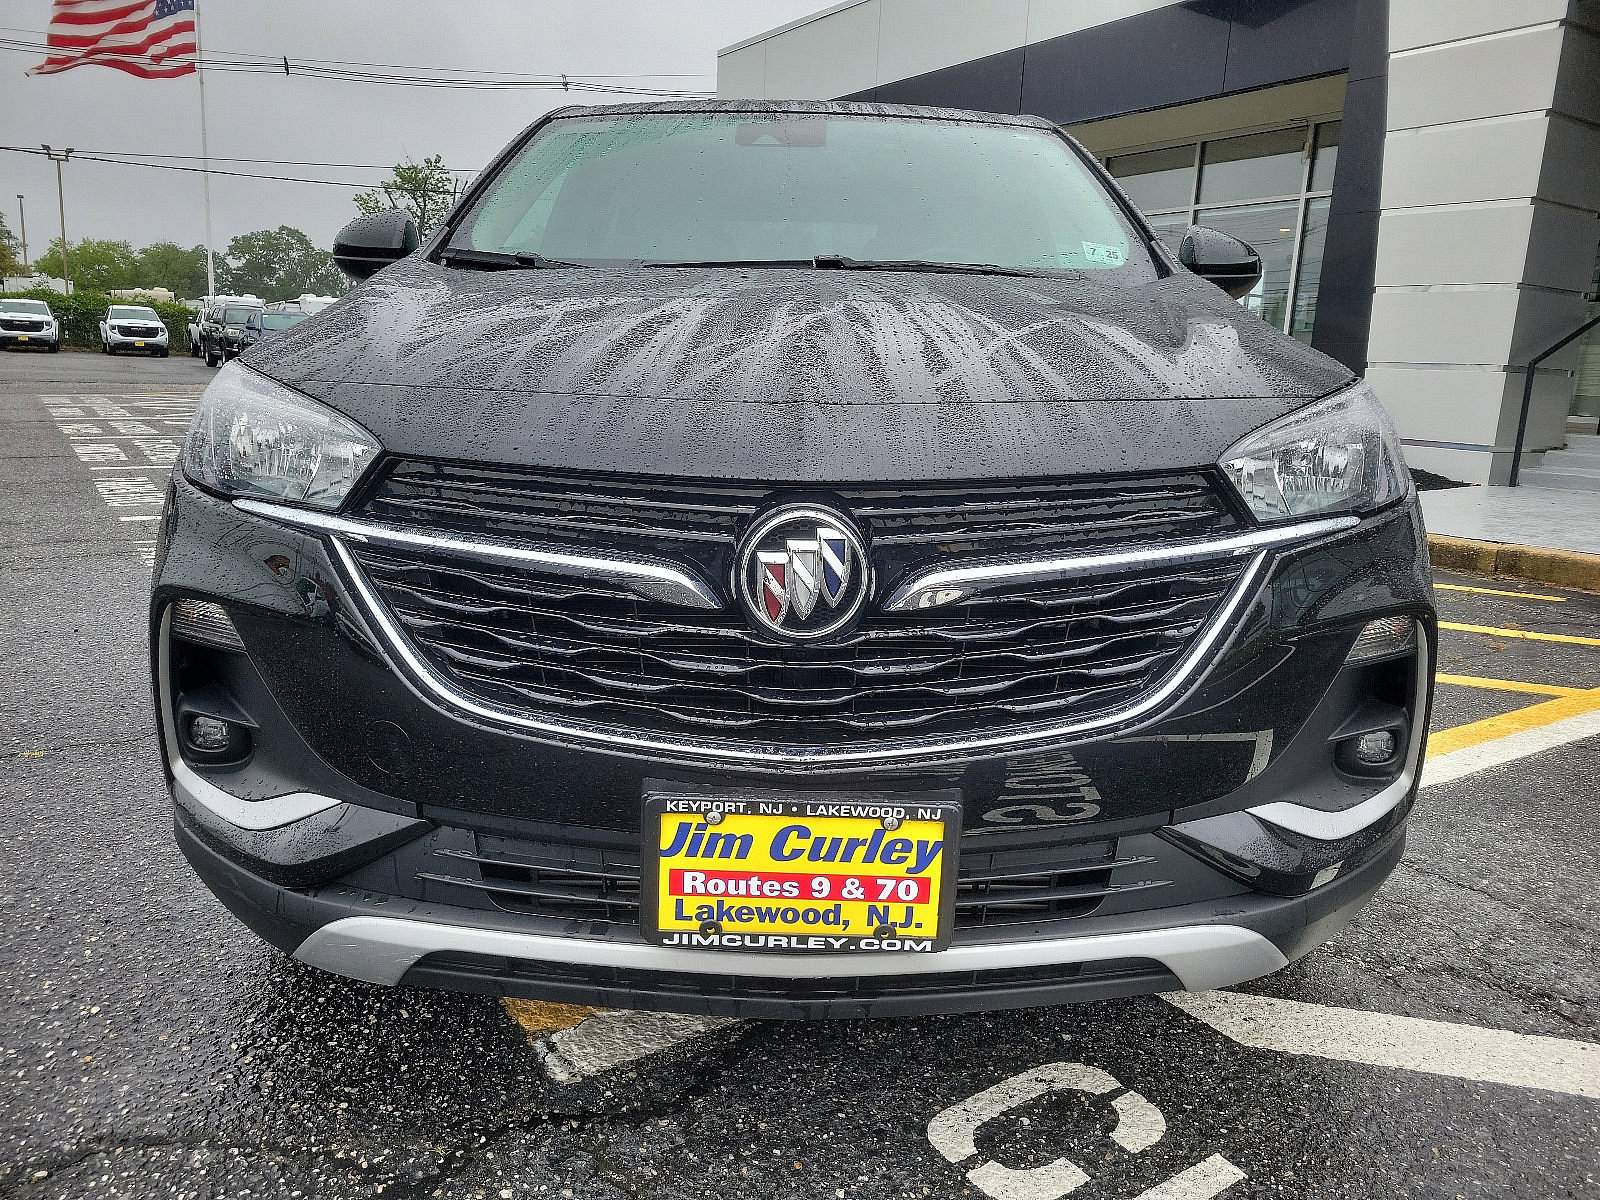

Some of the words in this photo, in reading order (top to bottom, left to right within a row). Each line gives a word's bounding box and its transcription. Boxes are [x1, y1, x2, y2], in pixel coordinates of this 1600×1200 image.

[1106, 250, 1119, 260] 25
[666, 800, 752, 814] KEYPORT,
[760, 803, 783, 814] NJ
[806, 804, 910, 820] LAKEWOOD,
[918, 808, 942, 820] NJ
[660, 821, 754, 860] Jim
[769, 824, 944, 875] Curley
[683, 871, 800, 897] Routes
[811, 876, 831, 898] 9
[841, 878, 865, 899] &
[876, 879, 919, 901] 70
[675, 898, 850, 931] Lakewood,
[866, 904, 923, 929] N.J.
[662, 933, 933, 952] JIMCURLEY.COM
